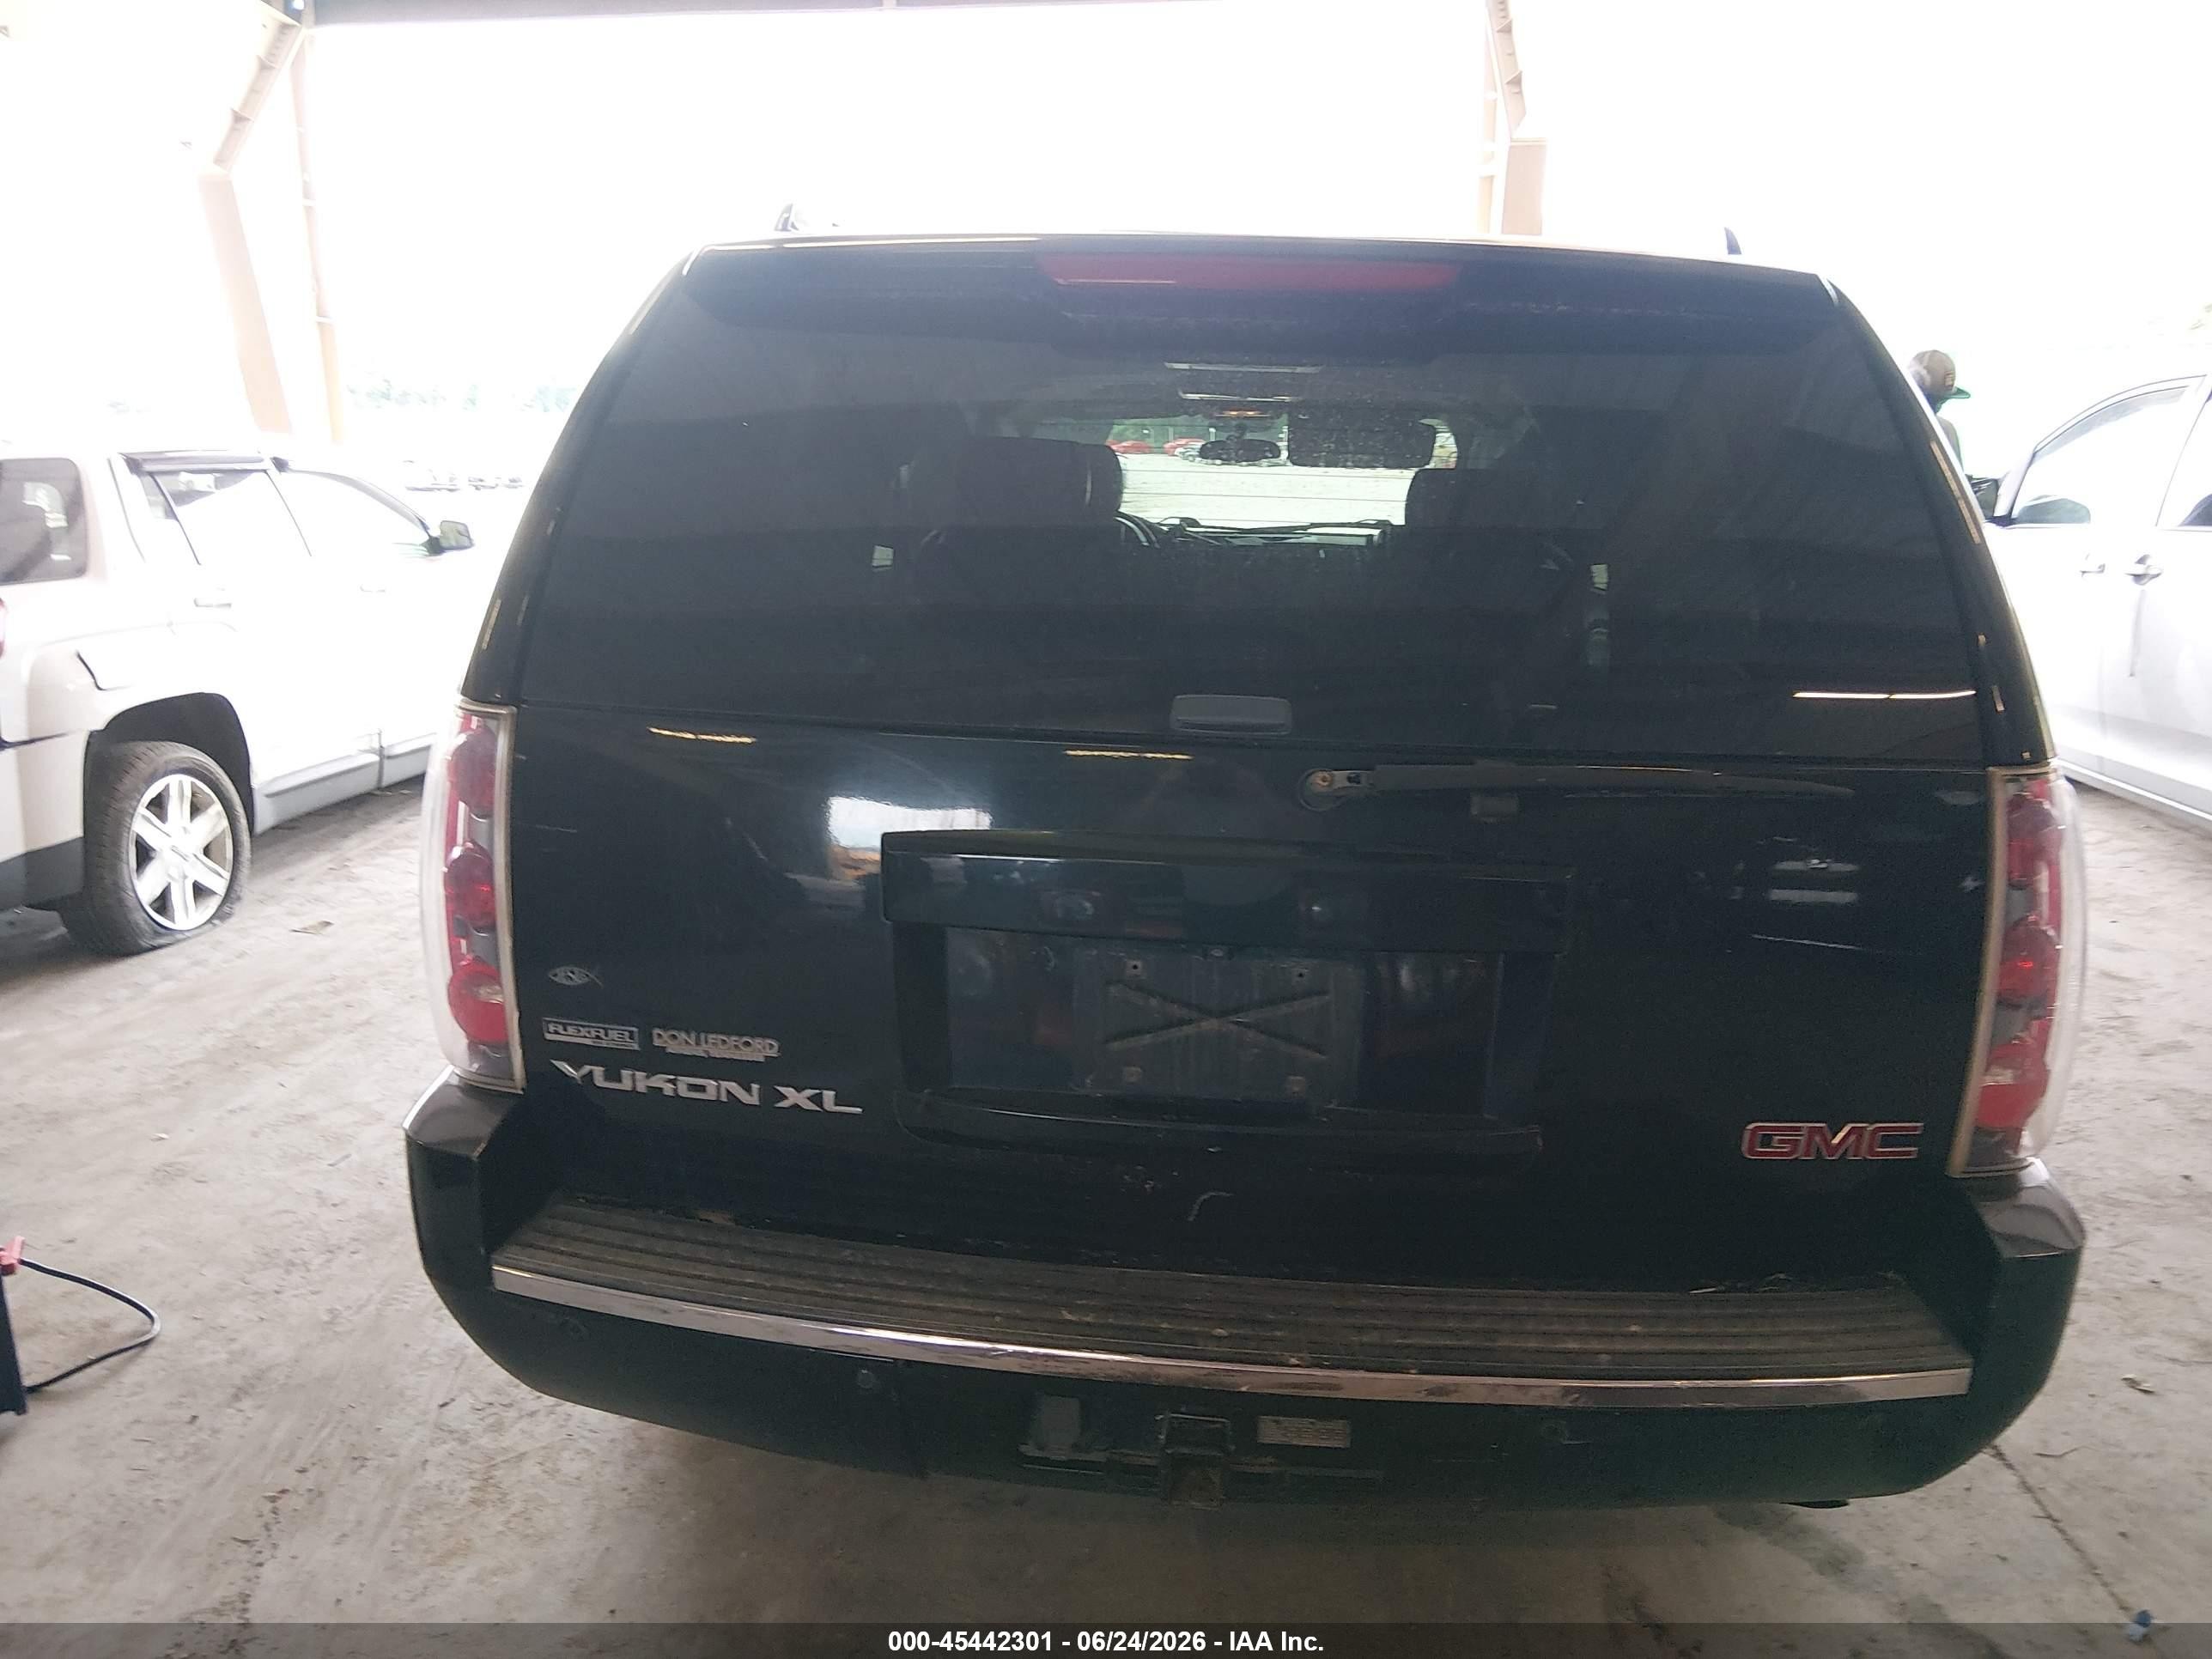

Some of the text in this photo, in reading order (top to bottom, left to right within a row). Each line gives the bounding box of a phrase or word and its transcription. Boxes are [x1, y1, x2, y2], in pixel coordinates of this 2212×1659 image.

[547, 1021, 635, 1043] FLEXFUEL
[652, 1027, 696, 1049] DON
[698, 1032, 781, 1057] LEDFORD
[550, 1059, 864, 1115] YUKON XL
[1741, 1121, 1924, 1160] GMC
